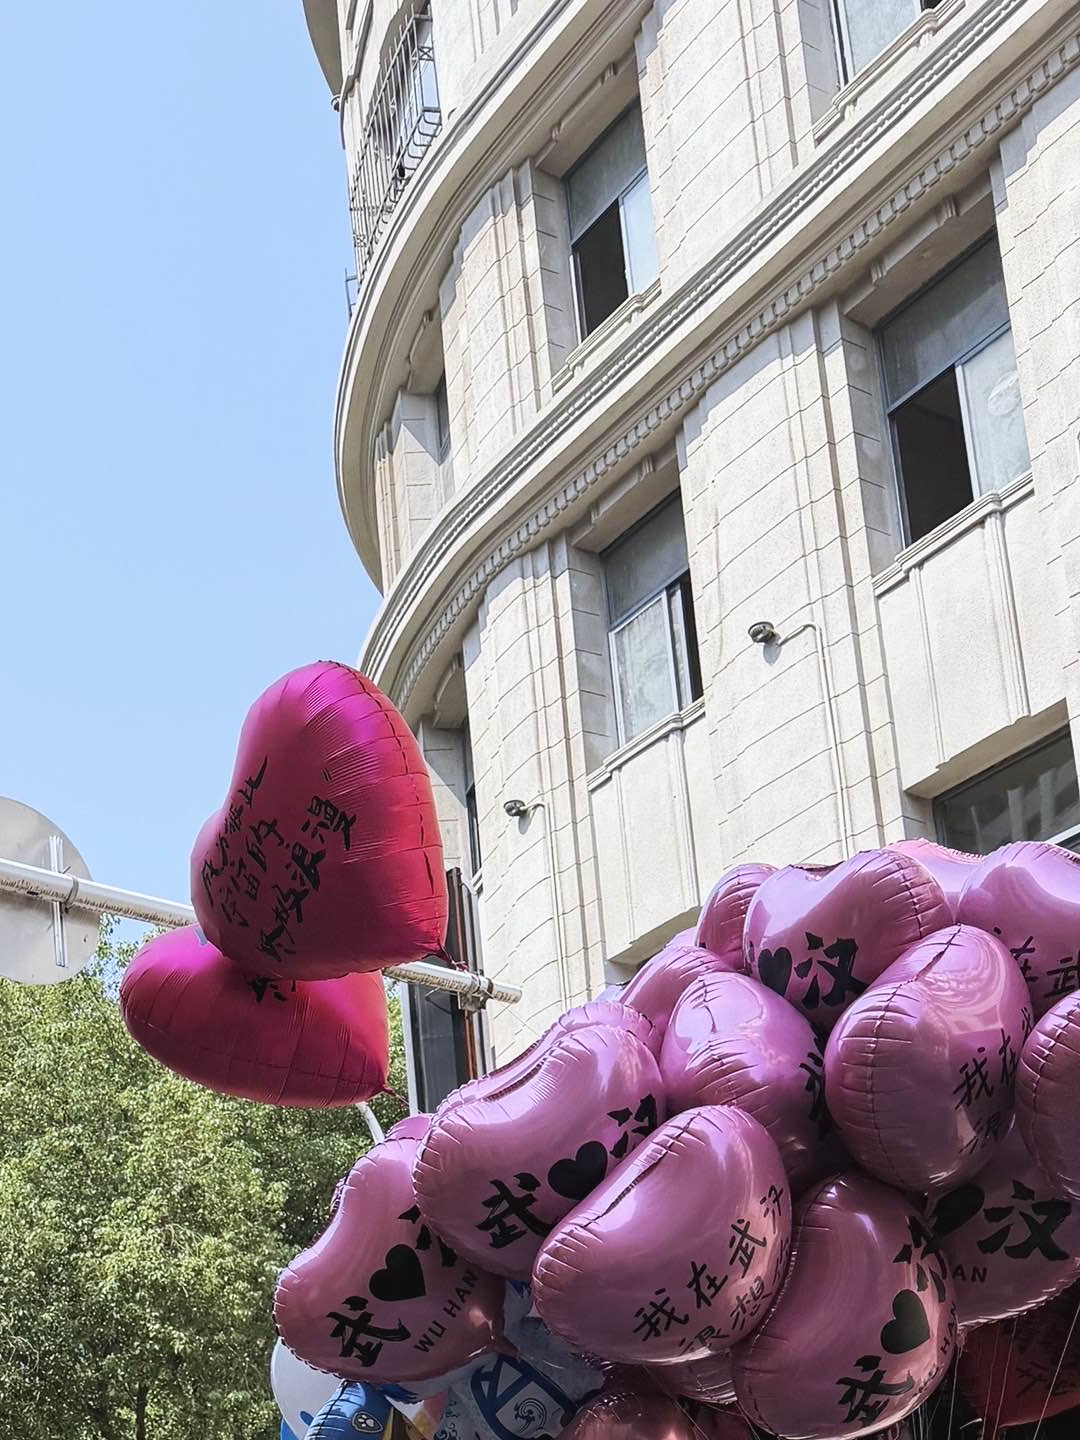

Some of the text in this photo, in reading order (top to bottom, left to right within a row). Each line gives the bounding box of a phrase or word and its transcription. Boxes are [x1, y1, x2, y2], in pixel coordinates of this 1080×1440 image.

[476, 1172, 558, 1250] 武
[976, 1179, 1073, 1261] 汉
[633, 1184, 786, 1341] 我在武汉
[326, 1295, 412, 1367] 武
[414, 1270, 479, 1353] WU HAN
